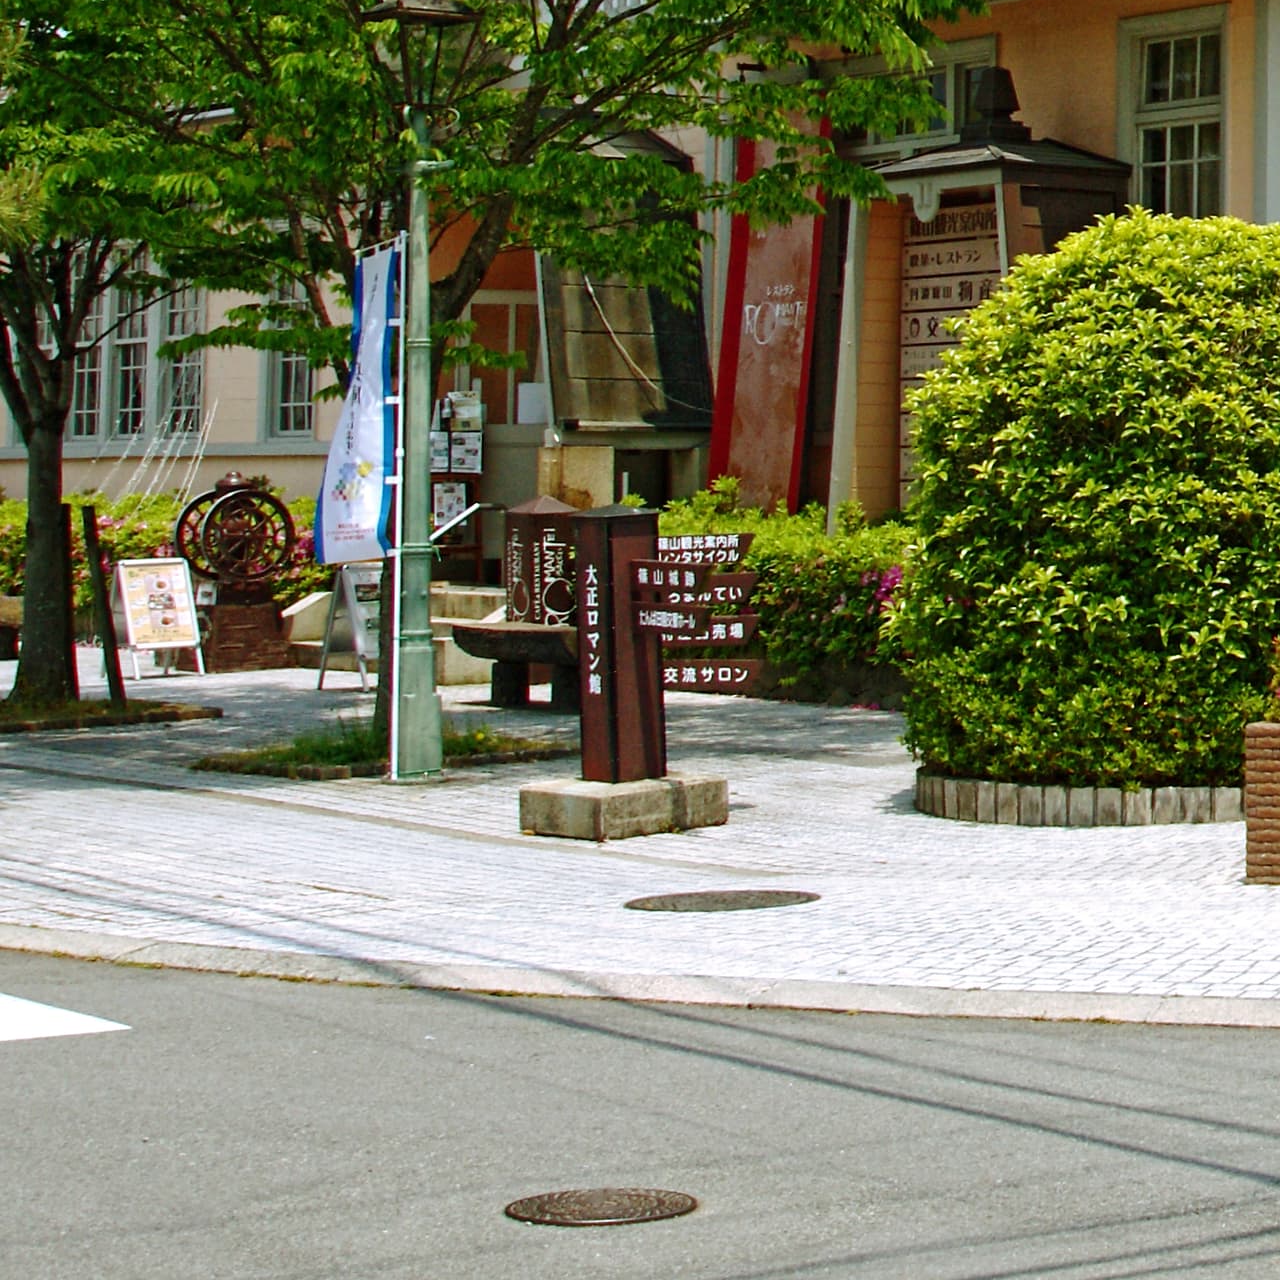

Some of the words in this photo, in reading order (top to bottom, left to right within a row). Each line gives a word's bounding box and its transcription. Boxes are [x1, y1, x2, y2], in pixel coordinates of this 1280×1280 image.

[585, 564, 602, 695] 大正ロマン館
[664, 667, 748, 684] 交流サロン
